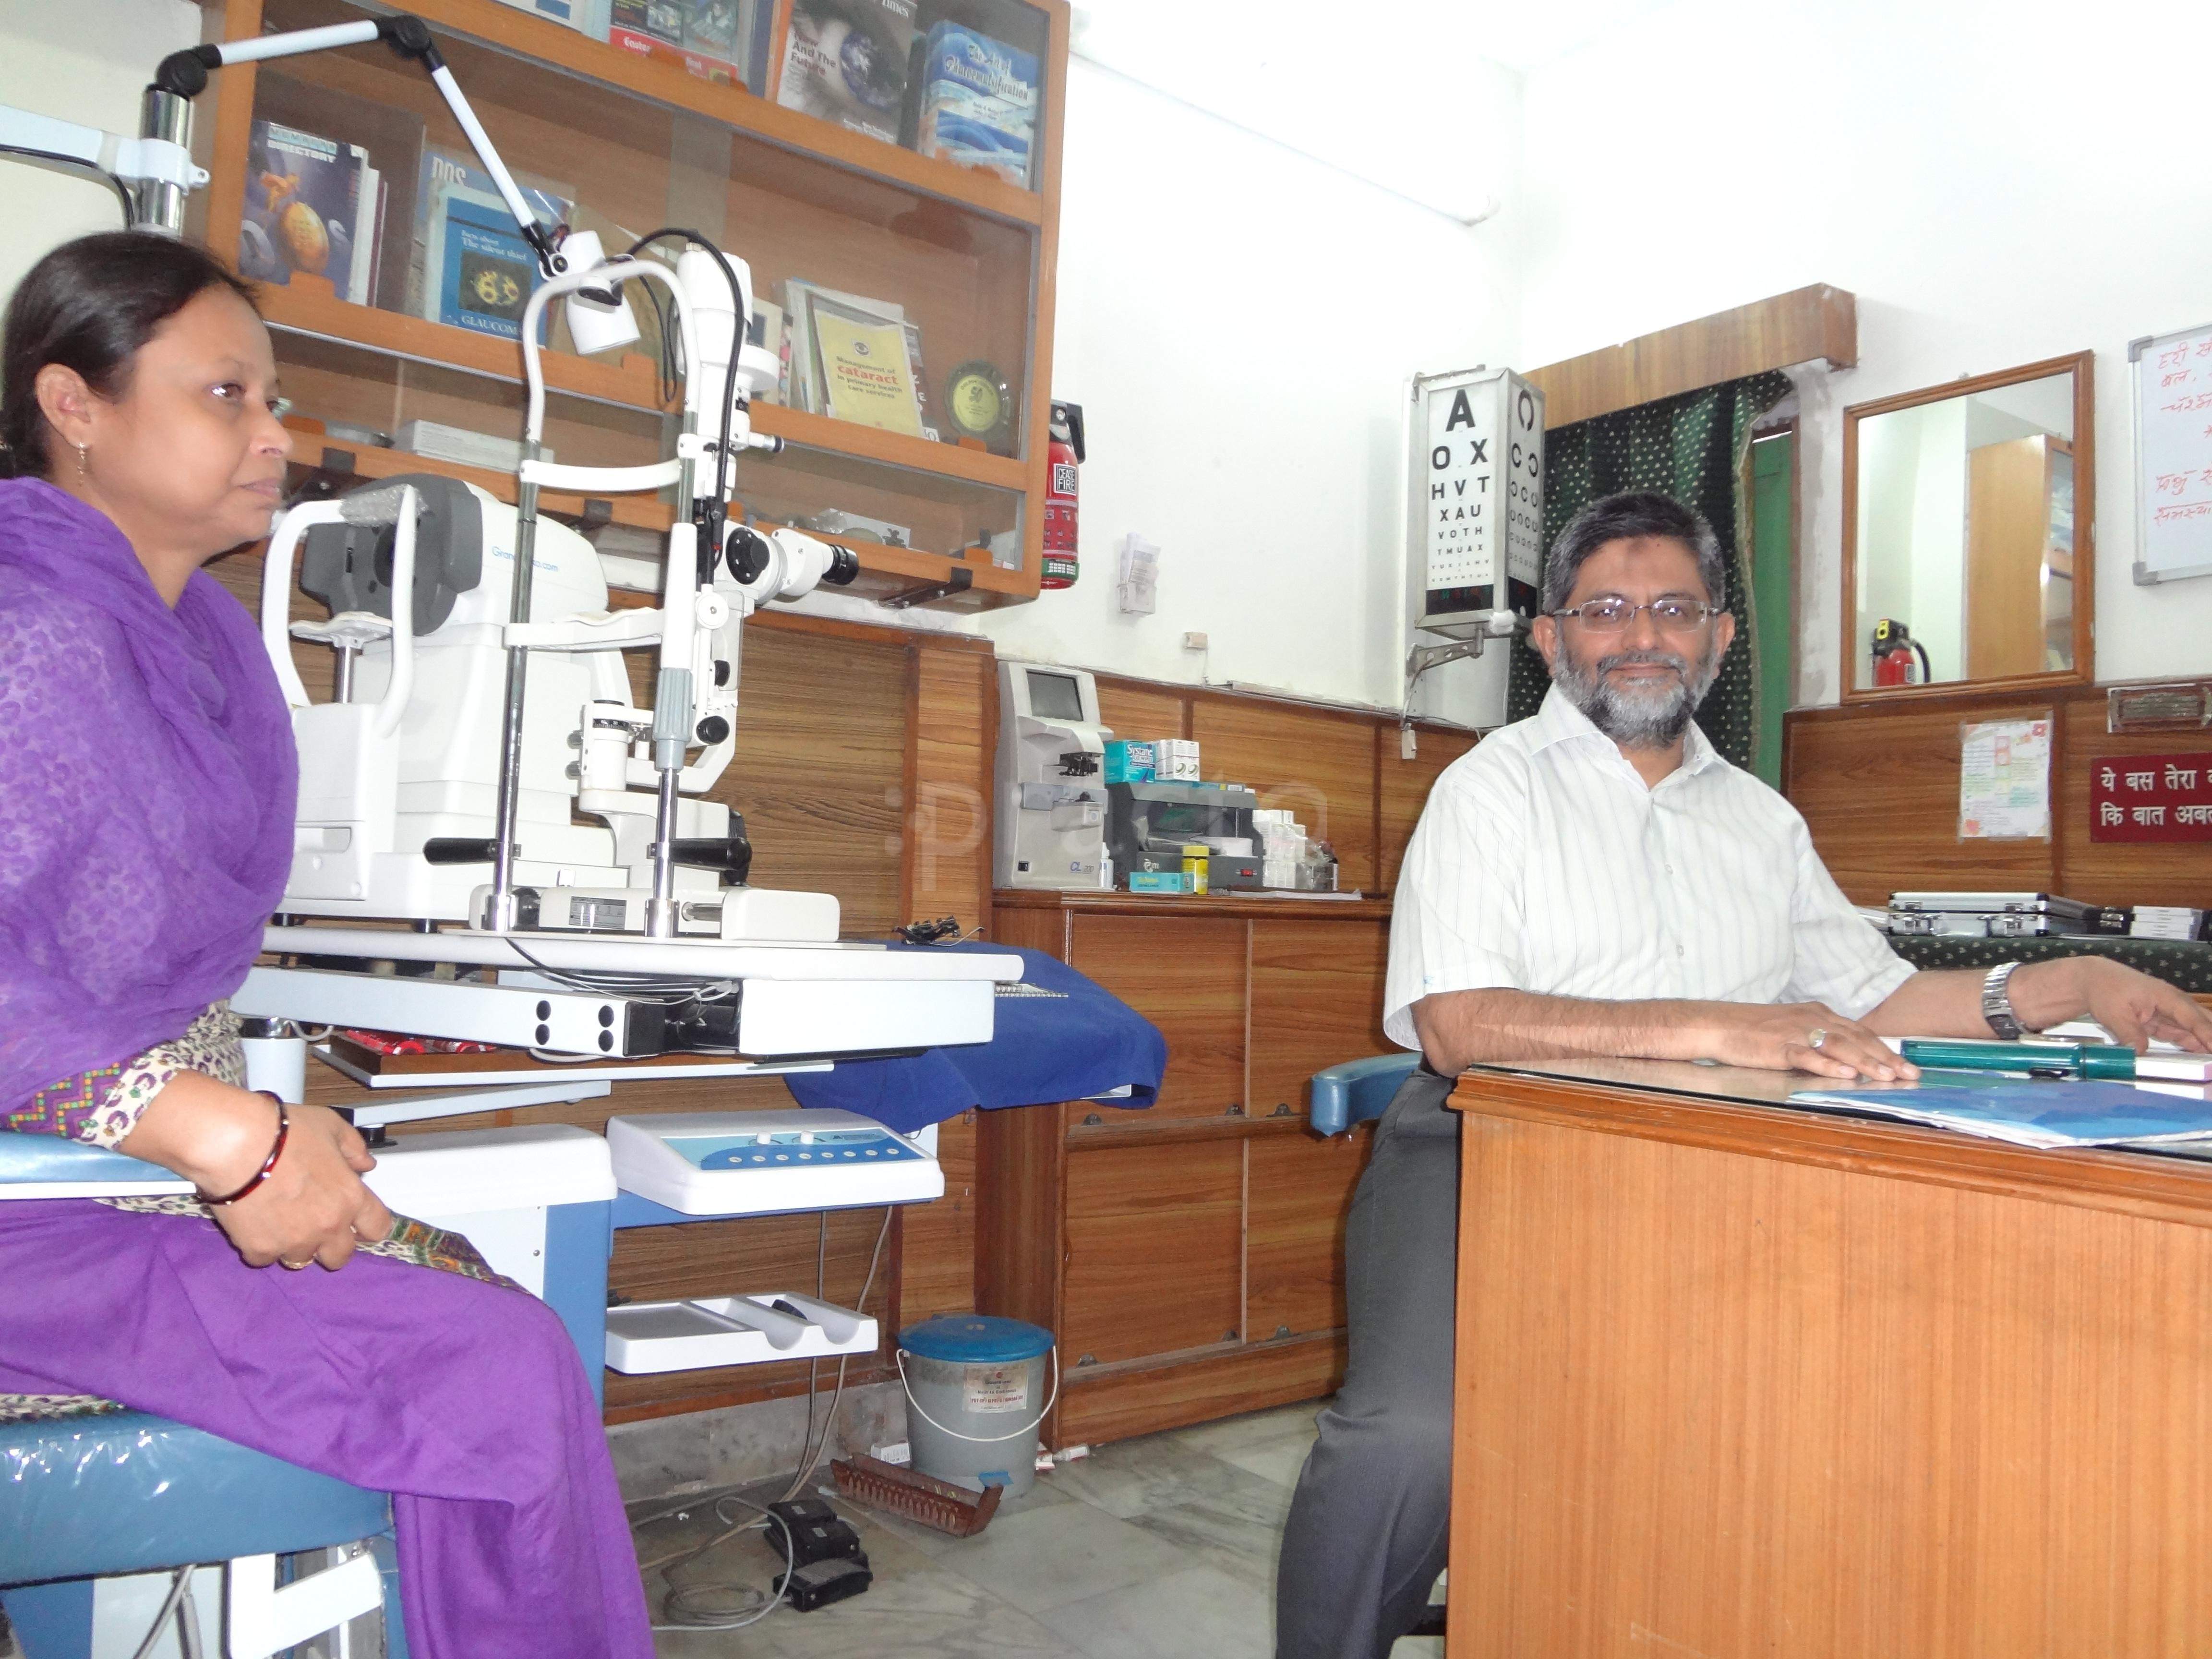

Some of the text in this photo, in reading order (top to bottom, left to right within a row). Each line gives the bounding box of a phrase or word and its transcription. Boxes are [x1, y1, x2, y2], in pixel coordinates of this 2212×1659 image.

[793, 41, 837, 68] And The
[969, 45, 983, 62] The
[791, 52, 826, 75] Future
[461, 315, 519, 335] GLAUCOM
[836, 356, 886, 373] Management
[837, 366, 899, 385] cataract
[1445, 389, 1476, 432] A
[1058, 468, 1075, 481] CEASE
[1058, 479, 1075, 492] FIRE
[1127, 744, 1153, 759] Systane
[2100, 767, 2116, 792] ये
[2125, 771, 2155, 791] बस
[2164, 764, 2197, 790] तेरा
[2100, 802, 2124, 827] कि
[2132, 805, 2166, 827] बात
